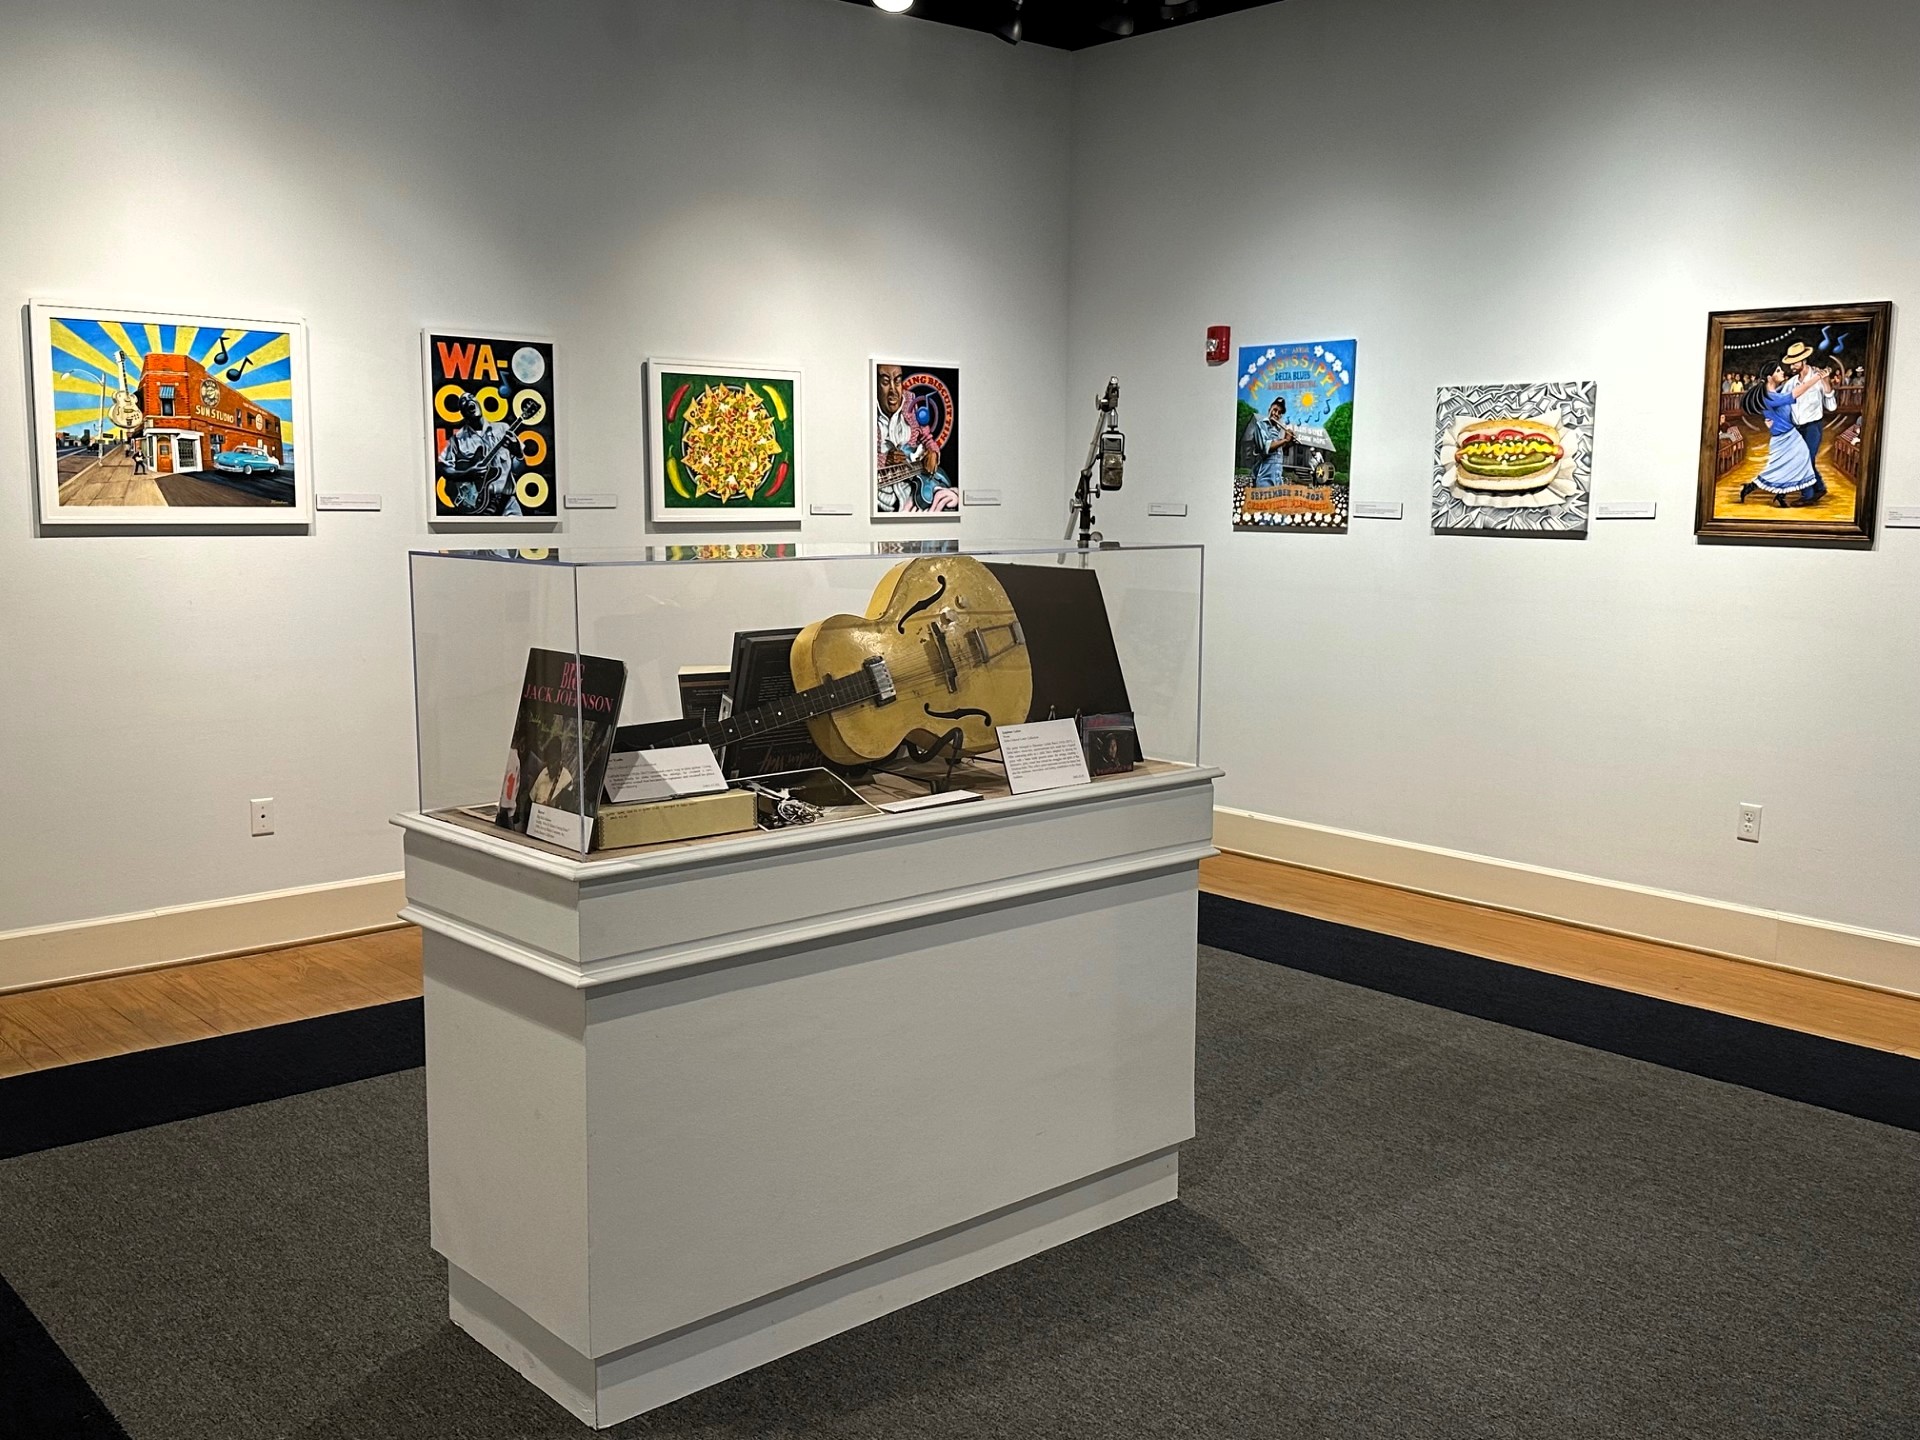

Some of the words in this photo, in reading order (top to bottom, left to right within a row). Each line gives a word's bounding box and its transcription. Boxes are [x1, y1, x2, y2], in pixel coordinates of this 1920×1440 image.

[1248, 354, 1342, 400] MISSISSIPPI
[1275, 371, 1292, 381] DELTA
[1293, 370, 1311, 380] BLUES
[902, 375, 927, 390] KING
[927, 376, 953, 417] BISCUIT
[195, 405, 211, 417] SUN
[211, 409, 234, 424] STUDIO
[1251, 489, 1291, 501] SEPTEMBER
[560, 661, 585, 691] BIG
[524, 684, 554, 703] JACK
[555, 690, 615, 713] JOHNSON
